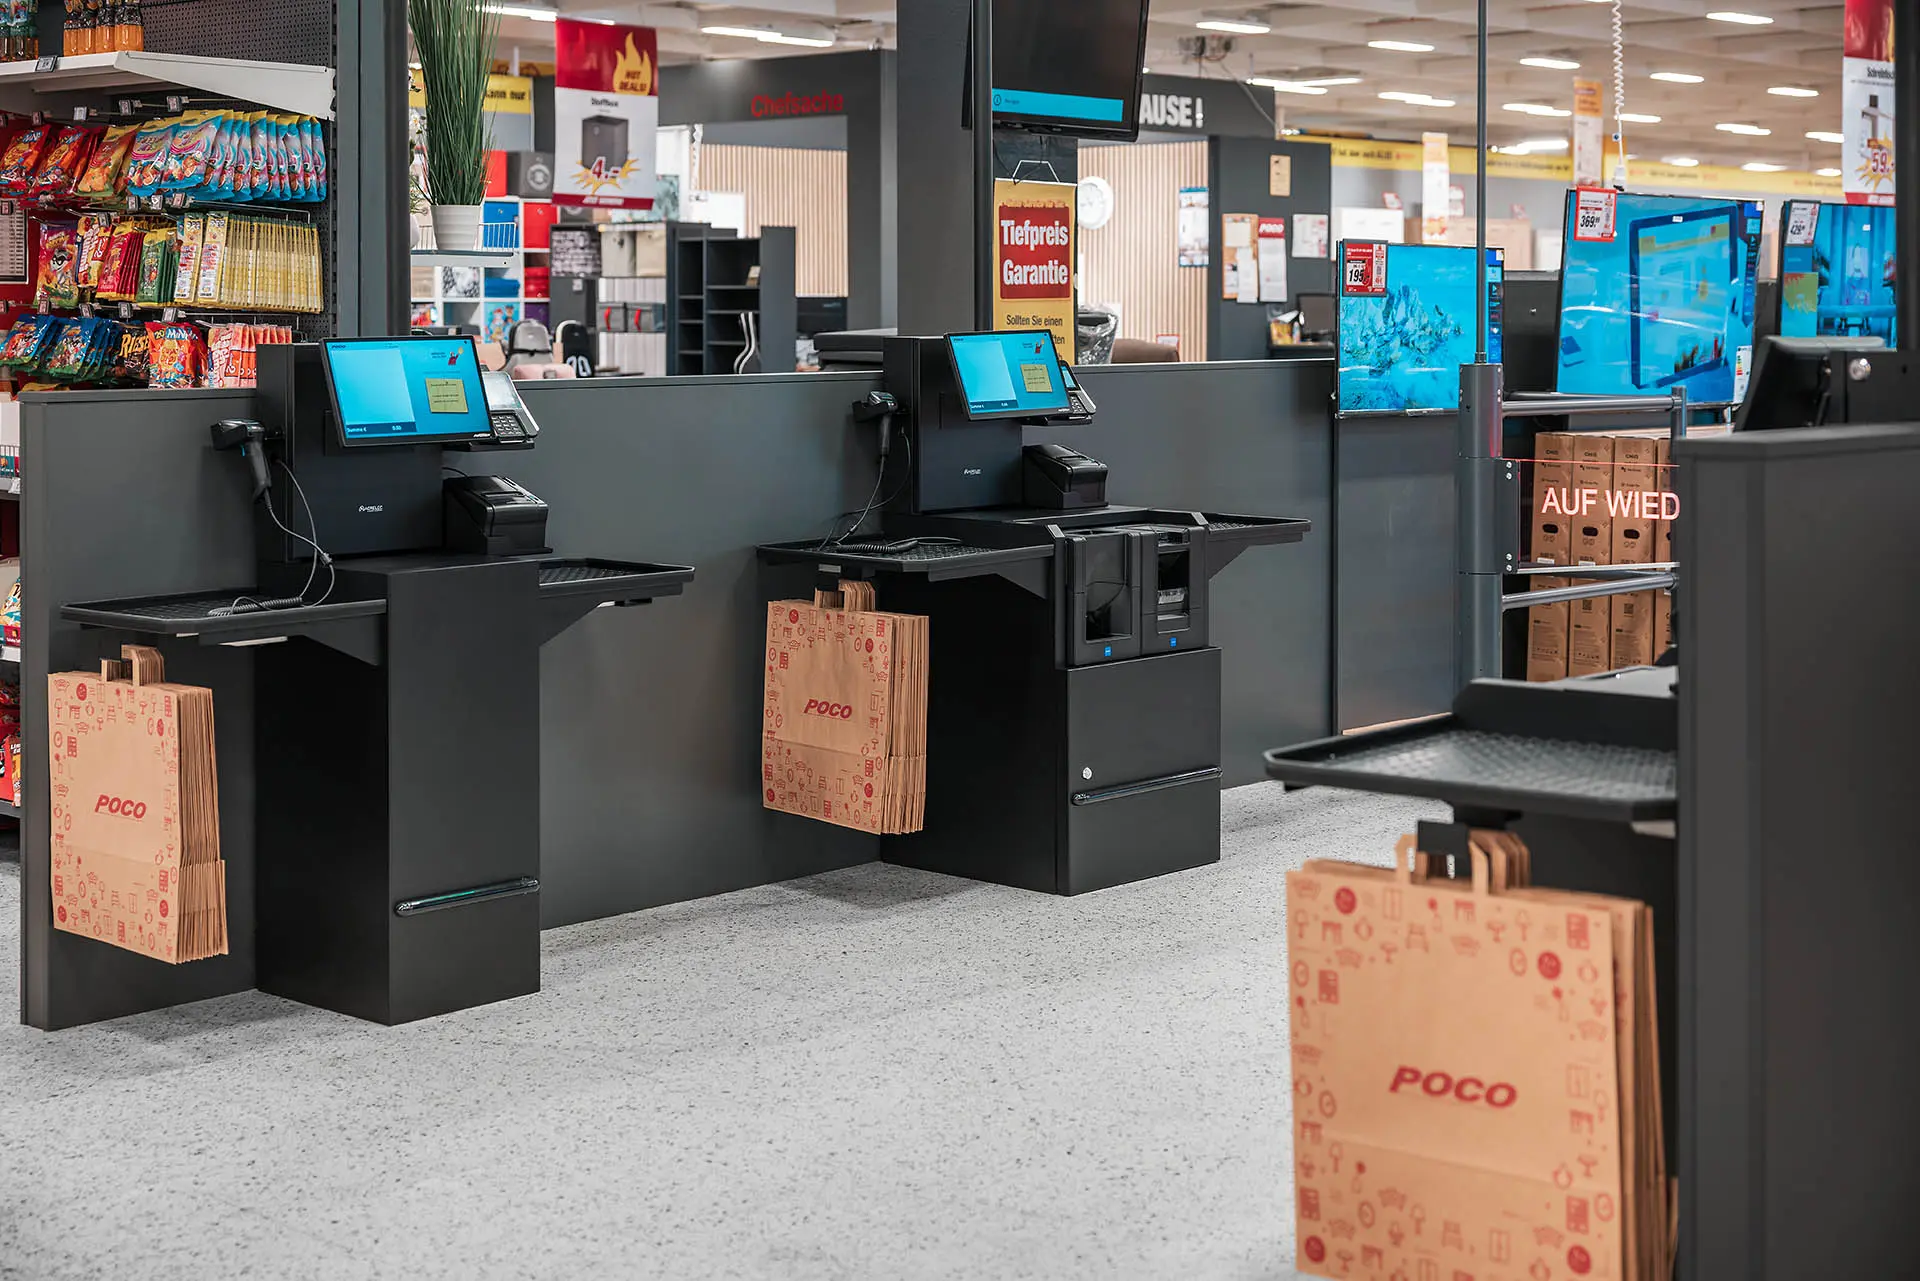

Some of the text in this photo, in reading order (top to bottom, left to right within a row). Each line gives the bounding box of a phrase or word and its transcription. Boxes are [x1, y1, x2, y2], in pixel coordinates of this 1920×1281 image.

[751, 88, 844, 118] Chefsache
[1001, 220, 1069, 251] Tiefpreis
[1003, 259, 1069, 285] Garantie
[1006, 314, 1063, 327] Sollten Sie einen
[1541, 487, 1681, 521] AUF WIED
[803, 699, 852, 719] POCO
[95, 794, 146, 819] POCO
[1389, 1065, 1518, 1109] POCO
